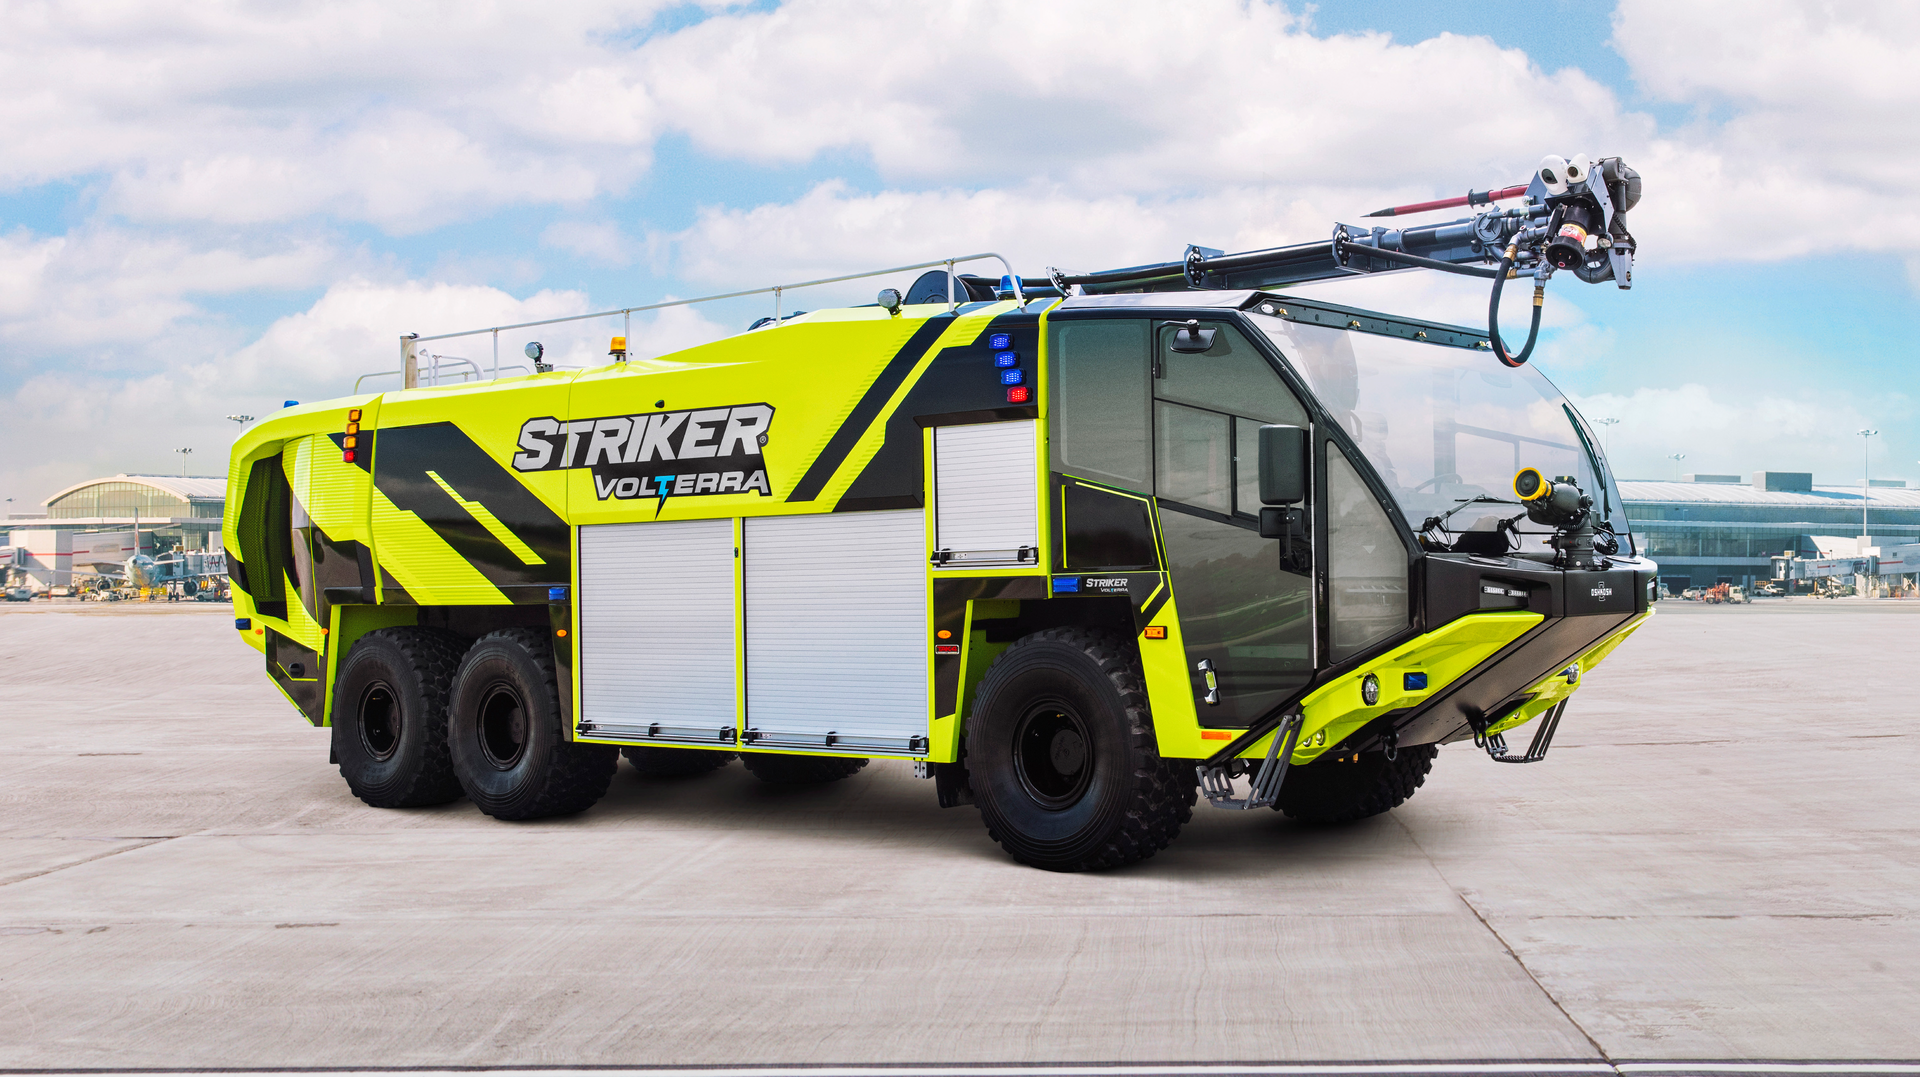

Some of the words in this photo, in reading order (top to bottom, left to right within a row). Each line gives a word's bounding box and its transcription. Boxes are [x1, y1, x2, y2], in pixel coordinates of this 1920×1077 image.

[594, 470, 769, 503] VOLTERRA
[1086, 578, 1128, 588] STRIKER
[1591, 588, 1612, 596] OSHKOSH
